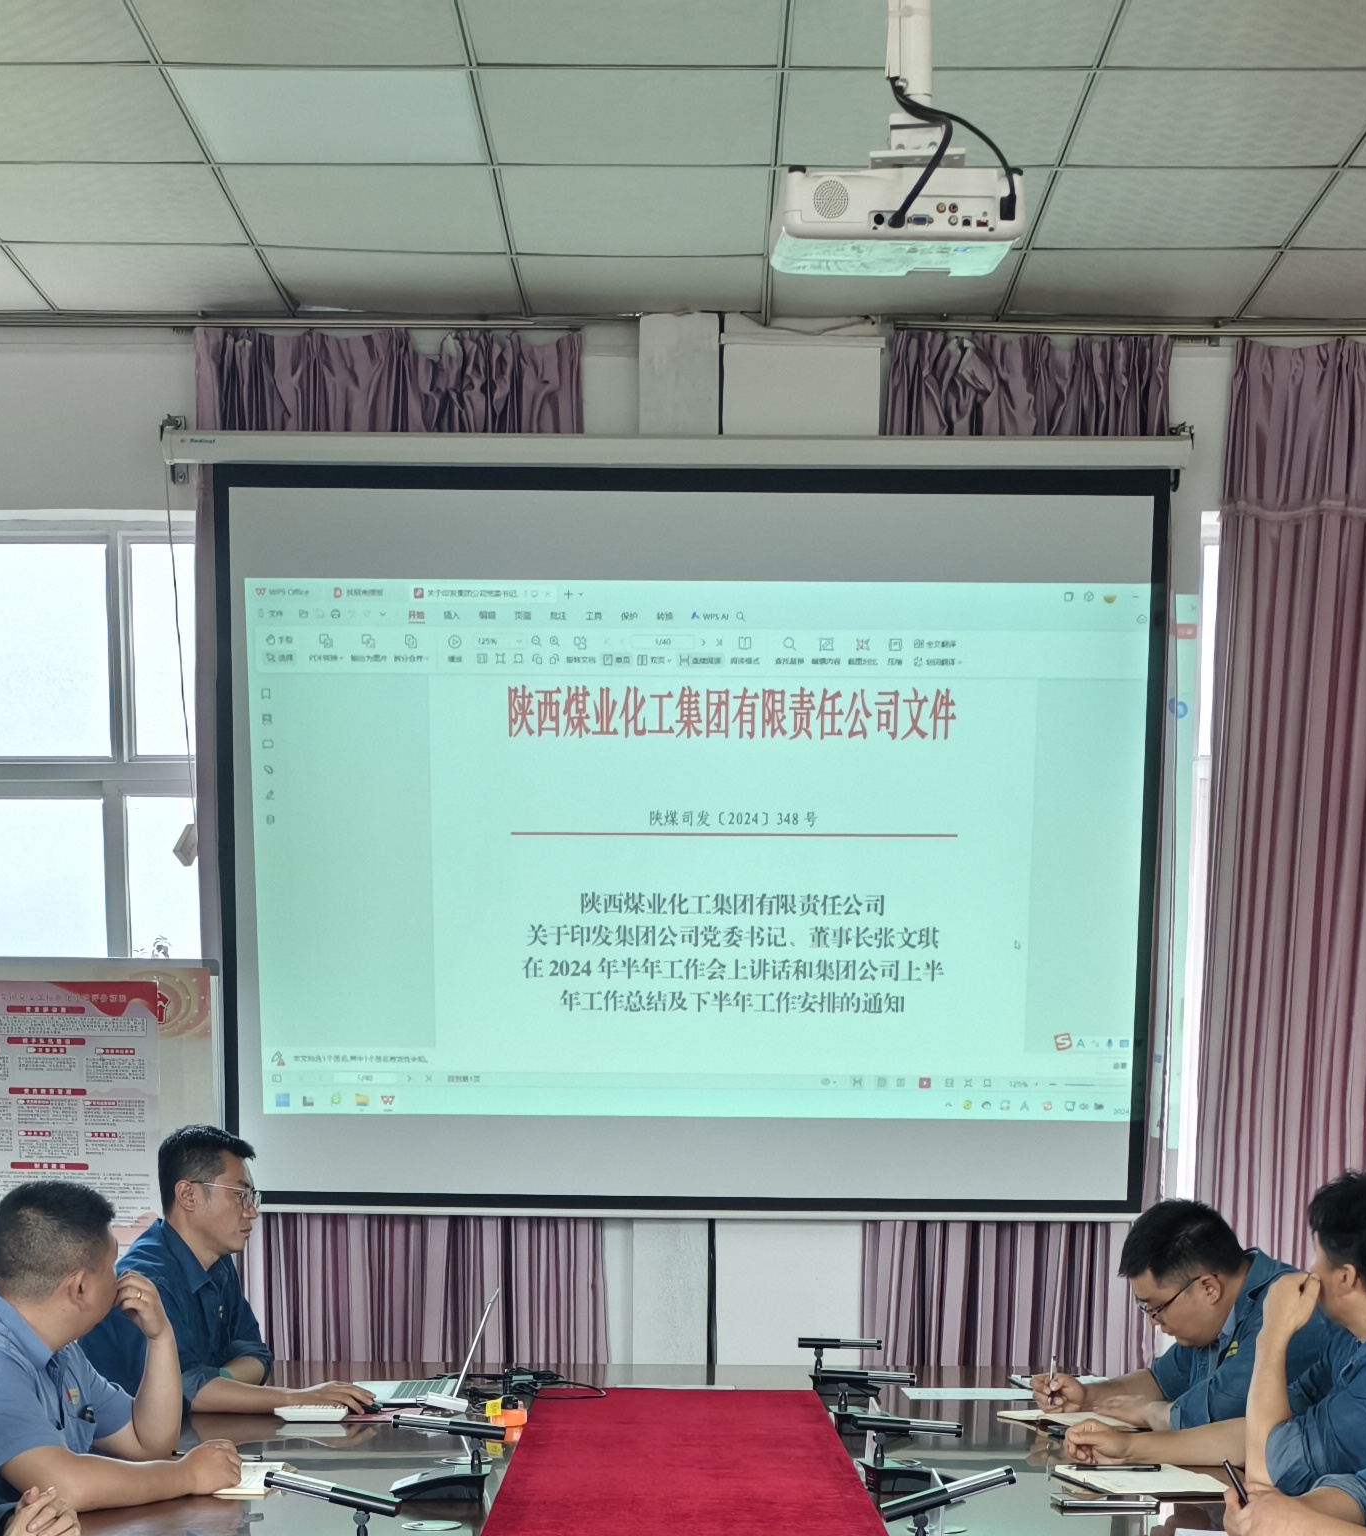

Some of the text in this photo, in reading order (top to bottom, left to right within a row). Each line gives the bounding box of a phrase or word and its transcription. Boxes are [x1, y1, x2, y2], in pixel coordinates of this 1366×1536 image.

[408, 611, 426, 621] 开始
[443, 611, 461, 621] 插入
[585, 611, 603, 621] 工具
[702, 612, 718, 621] WPS
[507, 684, 958, 742] 陕西煤业化工集团有限责任公司文件
[580, 891, 886, 918] 陕西煤业化工集团有限责任公司
[559, 989, 906, 1015] 年工作总结及下半年工作安排的通知
